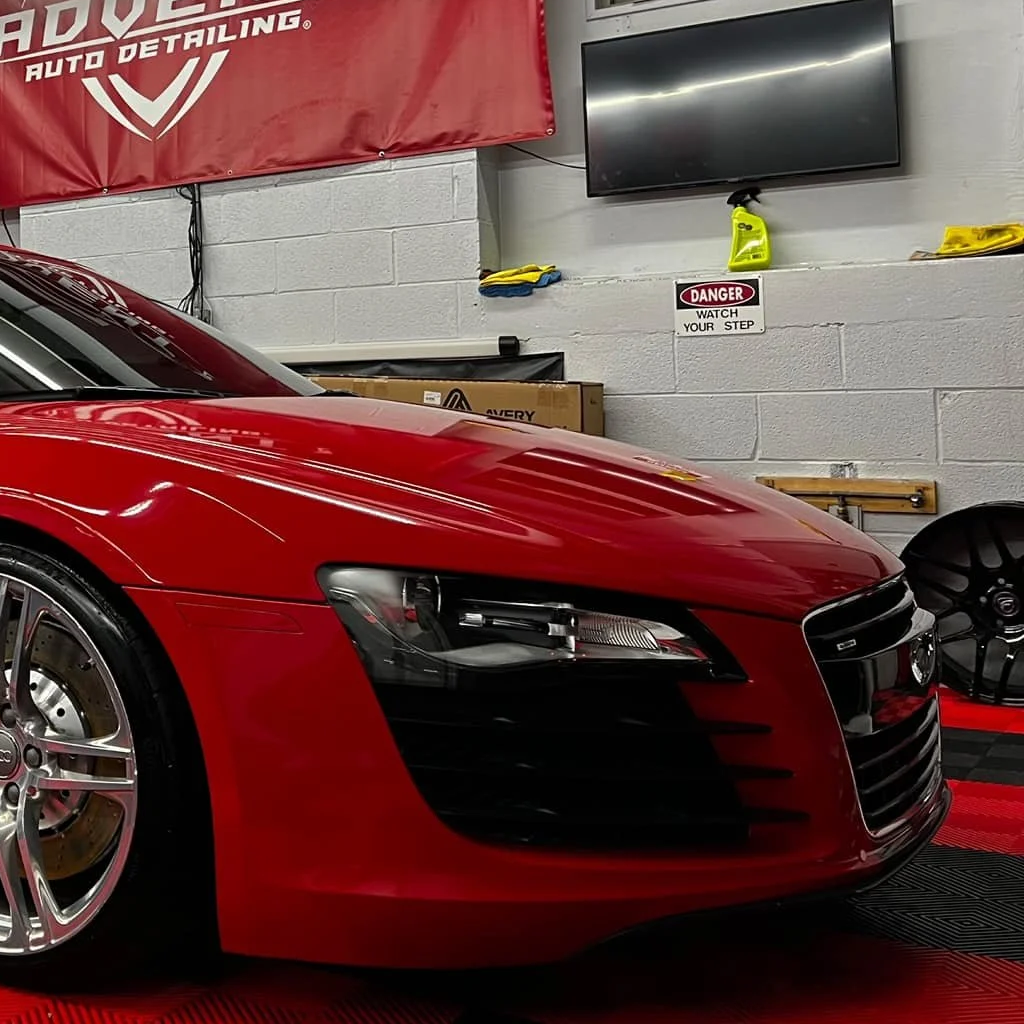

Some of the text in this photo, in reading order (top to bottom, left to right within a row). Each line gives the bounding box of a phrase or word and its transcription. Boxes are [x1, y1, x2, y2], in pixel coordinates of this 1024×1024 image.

[26, 50, 105, 82] AUTO
[690, 287, 744, 303] DANGER
[696, 309, 738, 319] WATCH
[684, 320, 755, 332] YOUR STEP
[486, 409, 536, 422] AVERY
